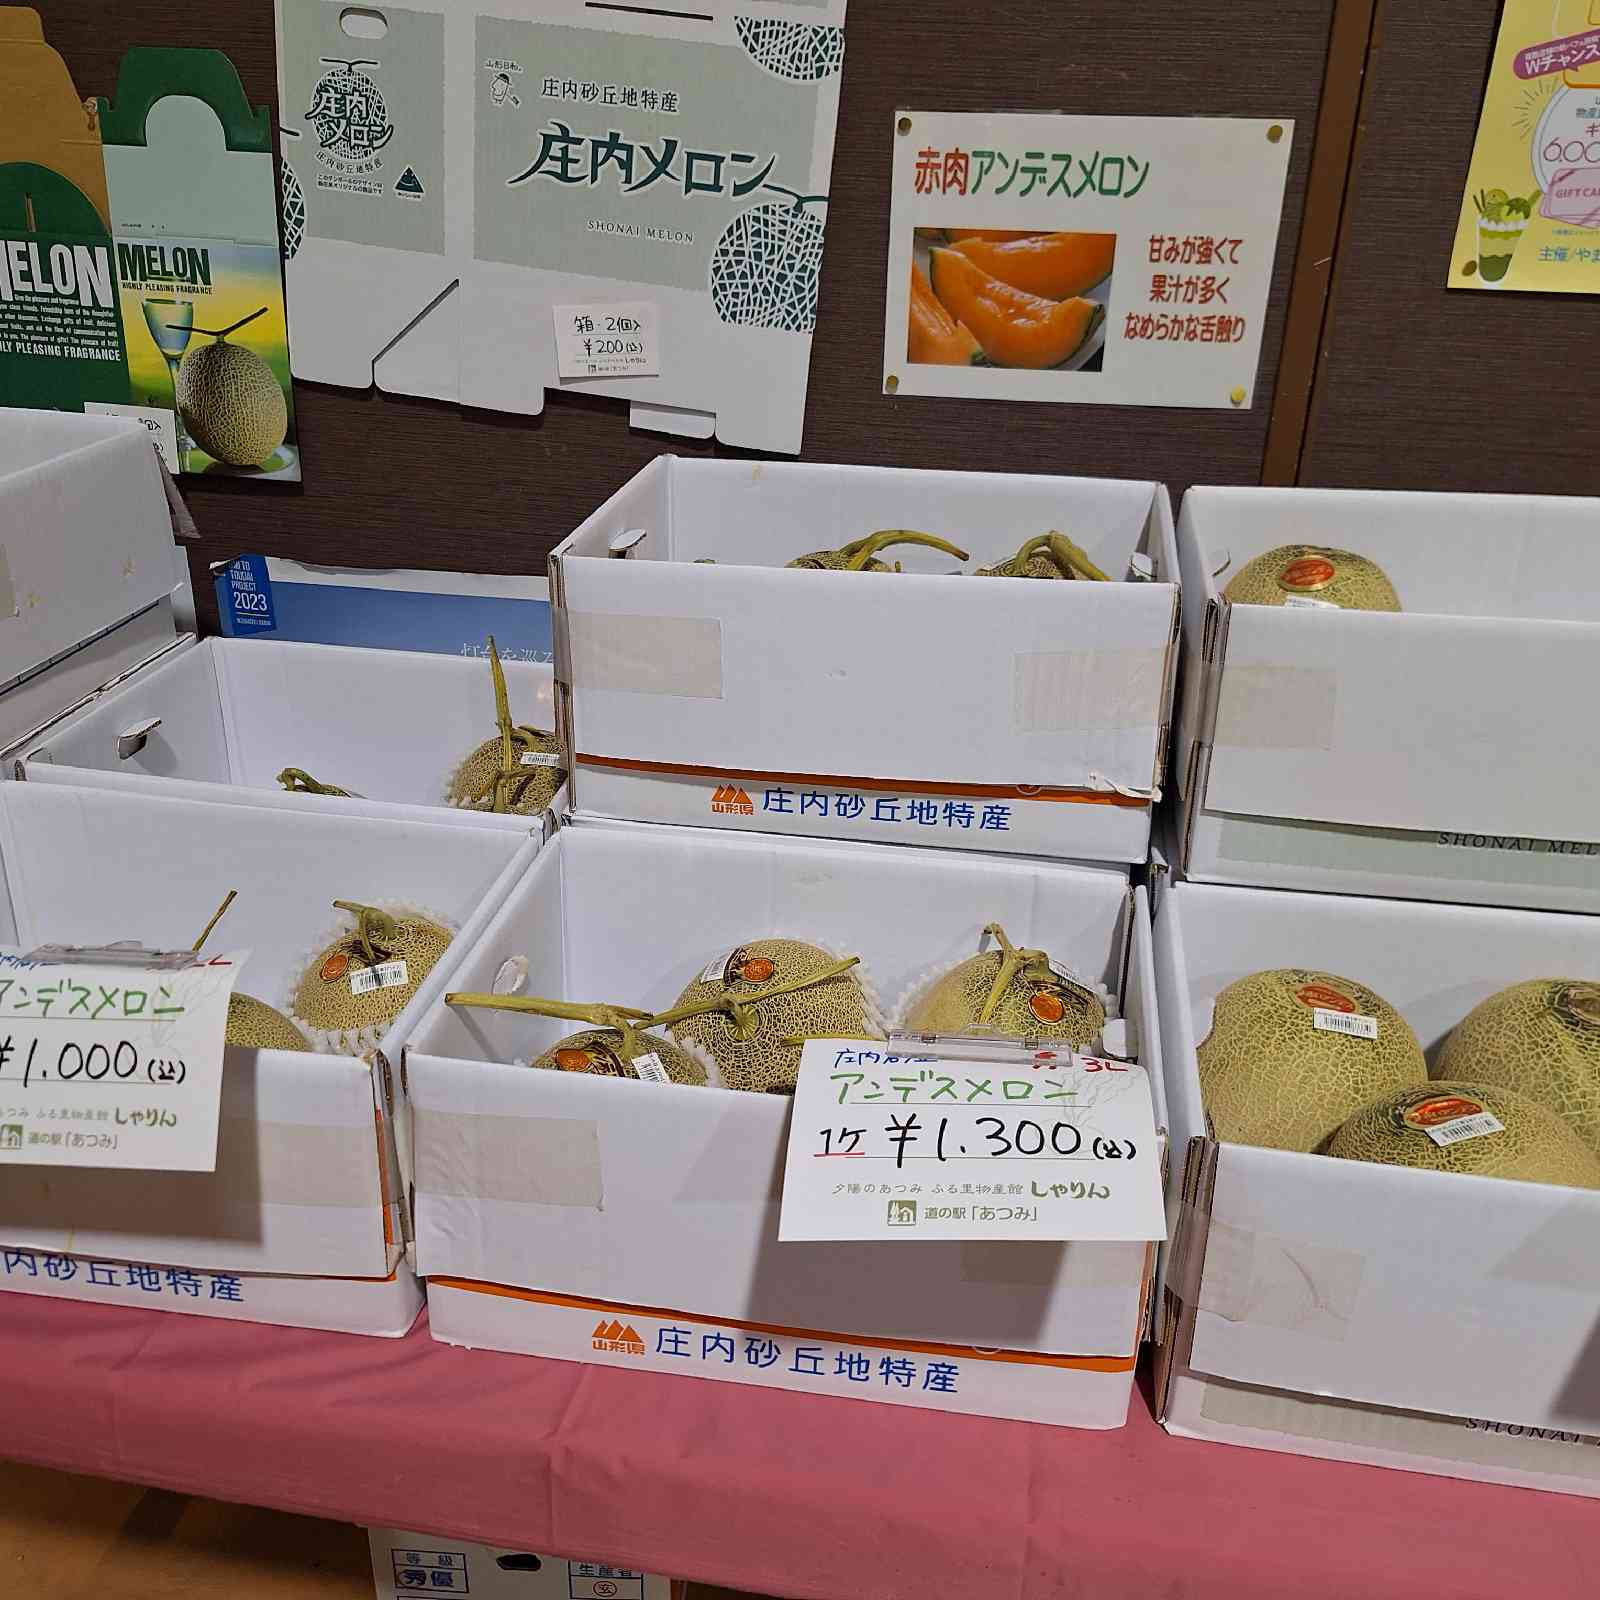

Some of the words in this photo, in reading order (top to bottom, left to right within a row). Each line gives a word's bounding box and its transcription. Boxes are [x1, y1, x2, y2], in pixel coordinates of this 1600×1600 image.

[541, 78, 678, 113] 庄内砂丘地特産
[507, 121, 776, 196] 庄内メロン
[914, 146, 1150, 199] 赤肉アンデスメロン
[1555, 188, 1580, 199] GIFT
[588, 220, 640, 238] SHONAI
[646, 226, 695, 243] MELON
[1148, 234, 1243, 265] 甘みが強くて
[117, 243, 211, 286] MELON
[145, 283, 175, 292] PLEASING
[176, 285, 213, 295] FRAGRANCE
[1149, 274, 1230, 305] 果汁が多く
[1123, 312, 1246, 344] なめらかな舌触り
[16, 341, 61, 357] PLEASING
[64, 345, 121, 361] FRAGRANCE
[231, 580, 256, 591] PROJECT
[233, 591, 268, 612] 2023
[711, 802, 754, 815] 山形県
[762, 787, 1013, 831] 庄内砂丘地特産
[1438, 831, 1534, 851] SHONAI
[1080, 1056, 1129, 1073] 3L
[830, 1069, 1079, 1105] アンデスメロン
[115, 1106, 178, 1127] しゃりん
[832, 1183, 923, 1196] 夕陽のあつみ
[931, 1183, 1024, 1196] ふる里物産館
[1031, 1180, 1111, 1199] しゃりん
[924, 1206, 1038, 1222] 道の駅「あつみ」
[4, 1247, 245, 1301] 内砂丘地特産
[592, 1340, 646, 1355] 山形県
[656, 1326, 960, 1394] 庄内砂丘地特産
[1465, 1417, 1580, 1443] SHONAI
